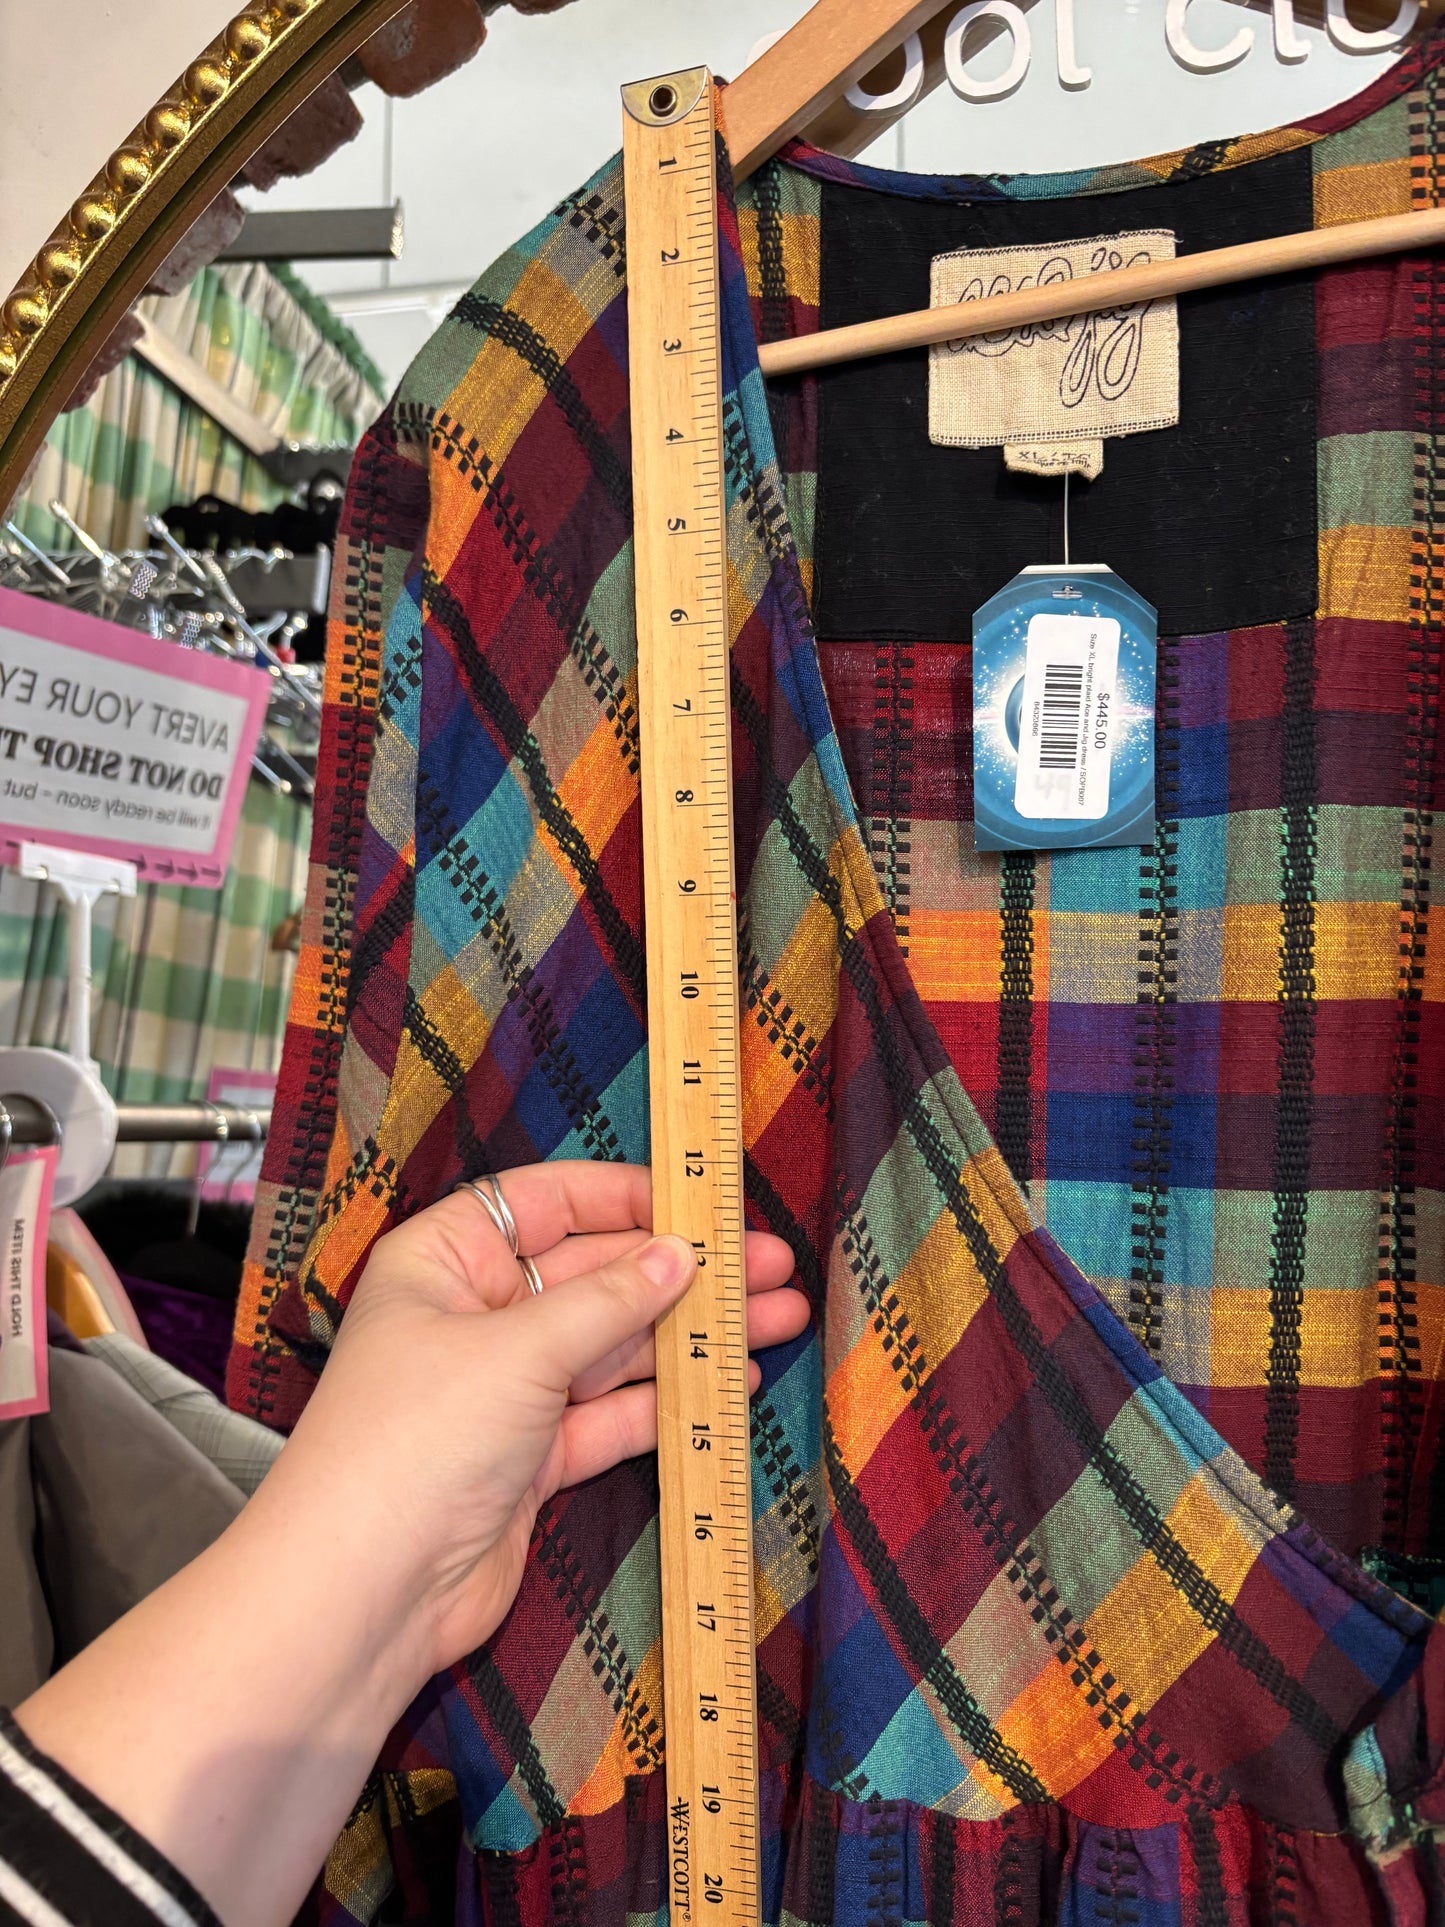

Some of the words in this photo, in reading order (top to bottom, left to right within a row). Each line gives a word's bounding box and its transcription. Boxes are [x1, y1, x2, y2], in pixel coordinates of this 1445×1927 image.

[658, 155, 676, 170] 1
[661, 247, 680, 263] 2
[663, 338, 682, 353] 3
[665, 428, 684, 442] 4
[667, 518, 686, 532] 5
[669, 609, 689, 623] 6
[1089, 633, 1097, 650] Size
[1088, 651, 1096, 662] XL
[1085, 662, 1095, 684] bright
[1083, 684, 1093, 703] plaid
[673, 698, 691, 713] 7
[1084, 703, 1092, 718] Ace
[1082, 719, 1091, 733] and
[1093, 693, 1111, 750] $445.00
[1080, 733, 1089, 746] Jig
[1080, 746, 1089, 767] dress
[675, 790, 694, 804] 8
[678, 879, 697, 893] 9
[680, 971, 700, 1000] 10
[682, 1059, 702, 1085] 11
[685, 1149, 705, 1178] 12
[689, 1330, 709, 1360] 14
[692, 1422, 711, 1452] 15
[694, 1511, 714, 1541] 16
[696, 1602, 717, 1632] 17
[699, 1692, 719, 1722] 18
[701, 1784, 722, 1815] 19
[670, 1795, 690, 1912] WESTCOTT
[704, 1873, 725, 1905] 20
